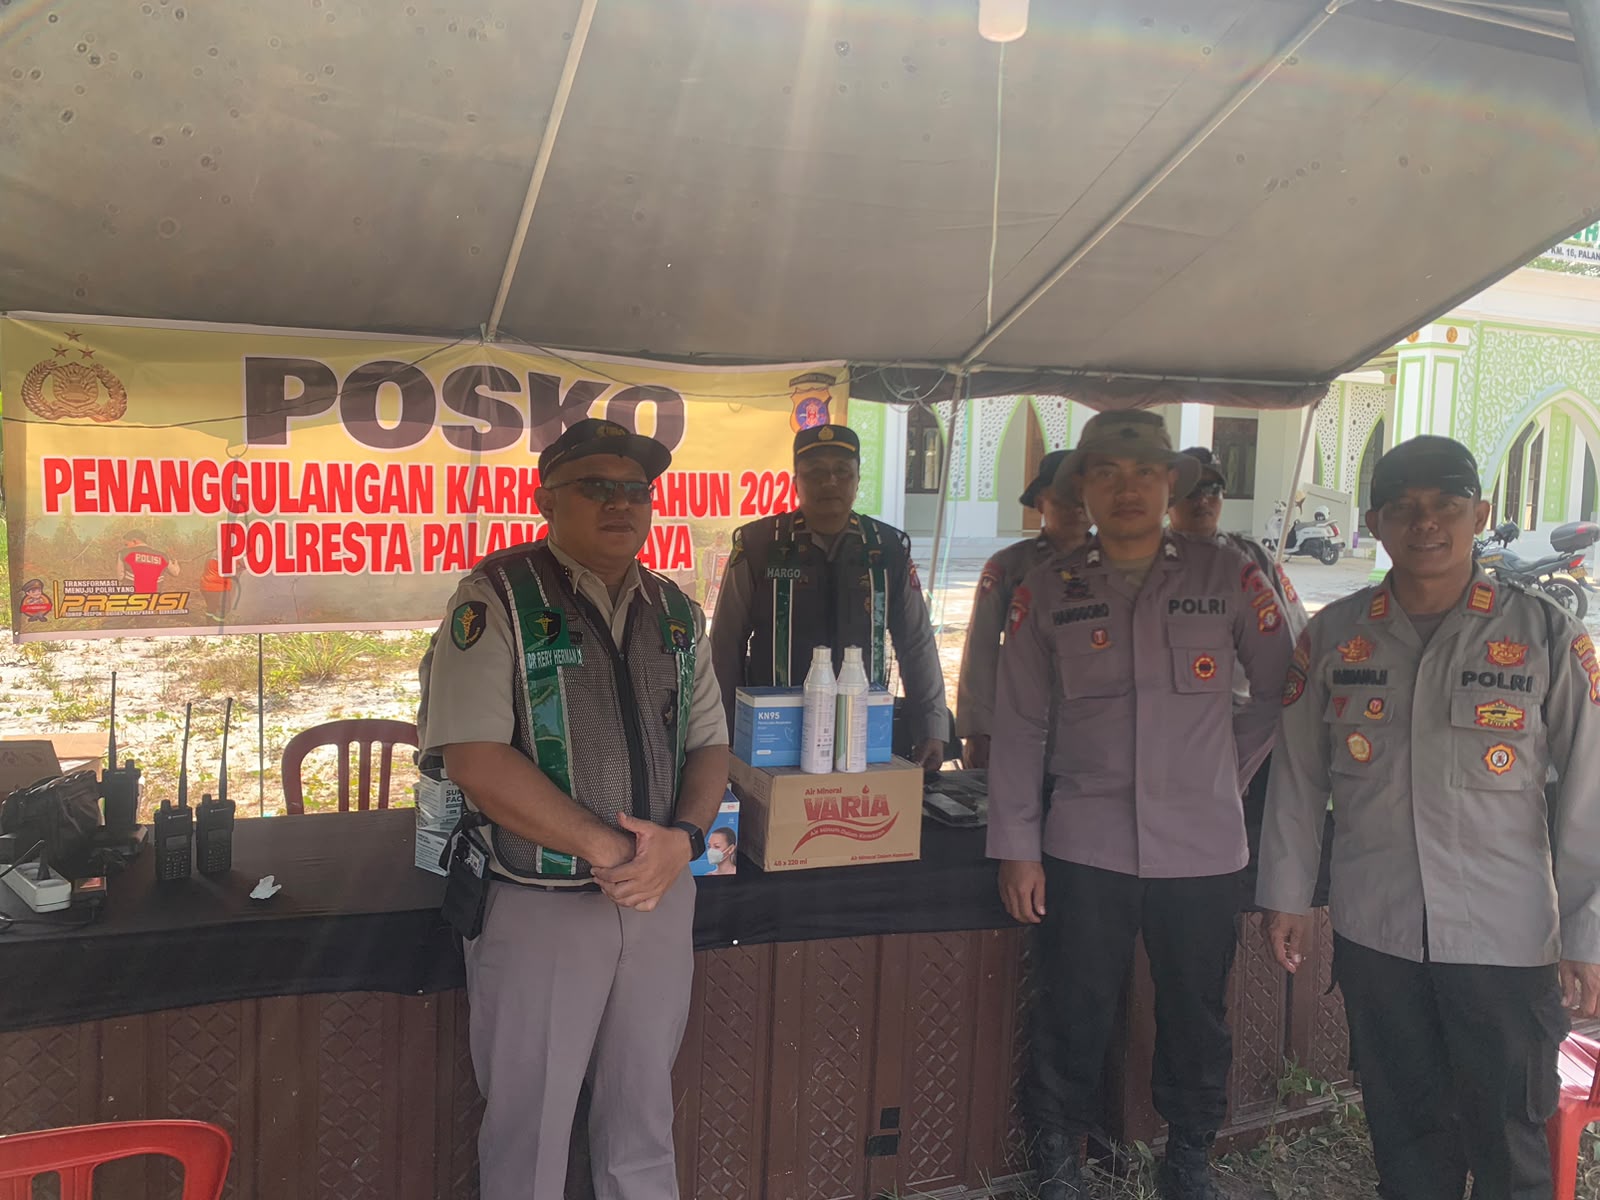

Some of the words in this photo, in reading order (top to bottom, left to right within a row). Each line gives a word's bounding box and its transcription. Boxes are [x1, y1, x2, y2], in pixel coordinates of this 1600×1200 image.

[245, 357, 684, 453] POSKO
[43, 458, 433, 514] PENANGGULANGAN
[447, 465, 541, 515] KARH
[650, 471, 730, 517] AHUN
[221, 522, 411, 574] POLRESTA
[635, 525, 693, 570] AYA
[135, 553, 162, 565] POLISI
[767, 567, 800, 578] HARGO
[64, 586, 94, 594] MENUJU
[60, 592, 189, 616] PRESISI
[1168, 599, 1226, 614] POLRI
[1462, 671, 1533, 692] POLRI
[758, 711, 780, 720] KN95
[817, 786, 842, 795] Mineral
